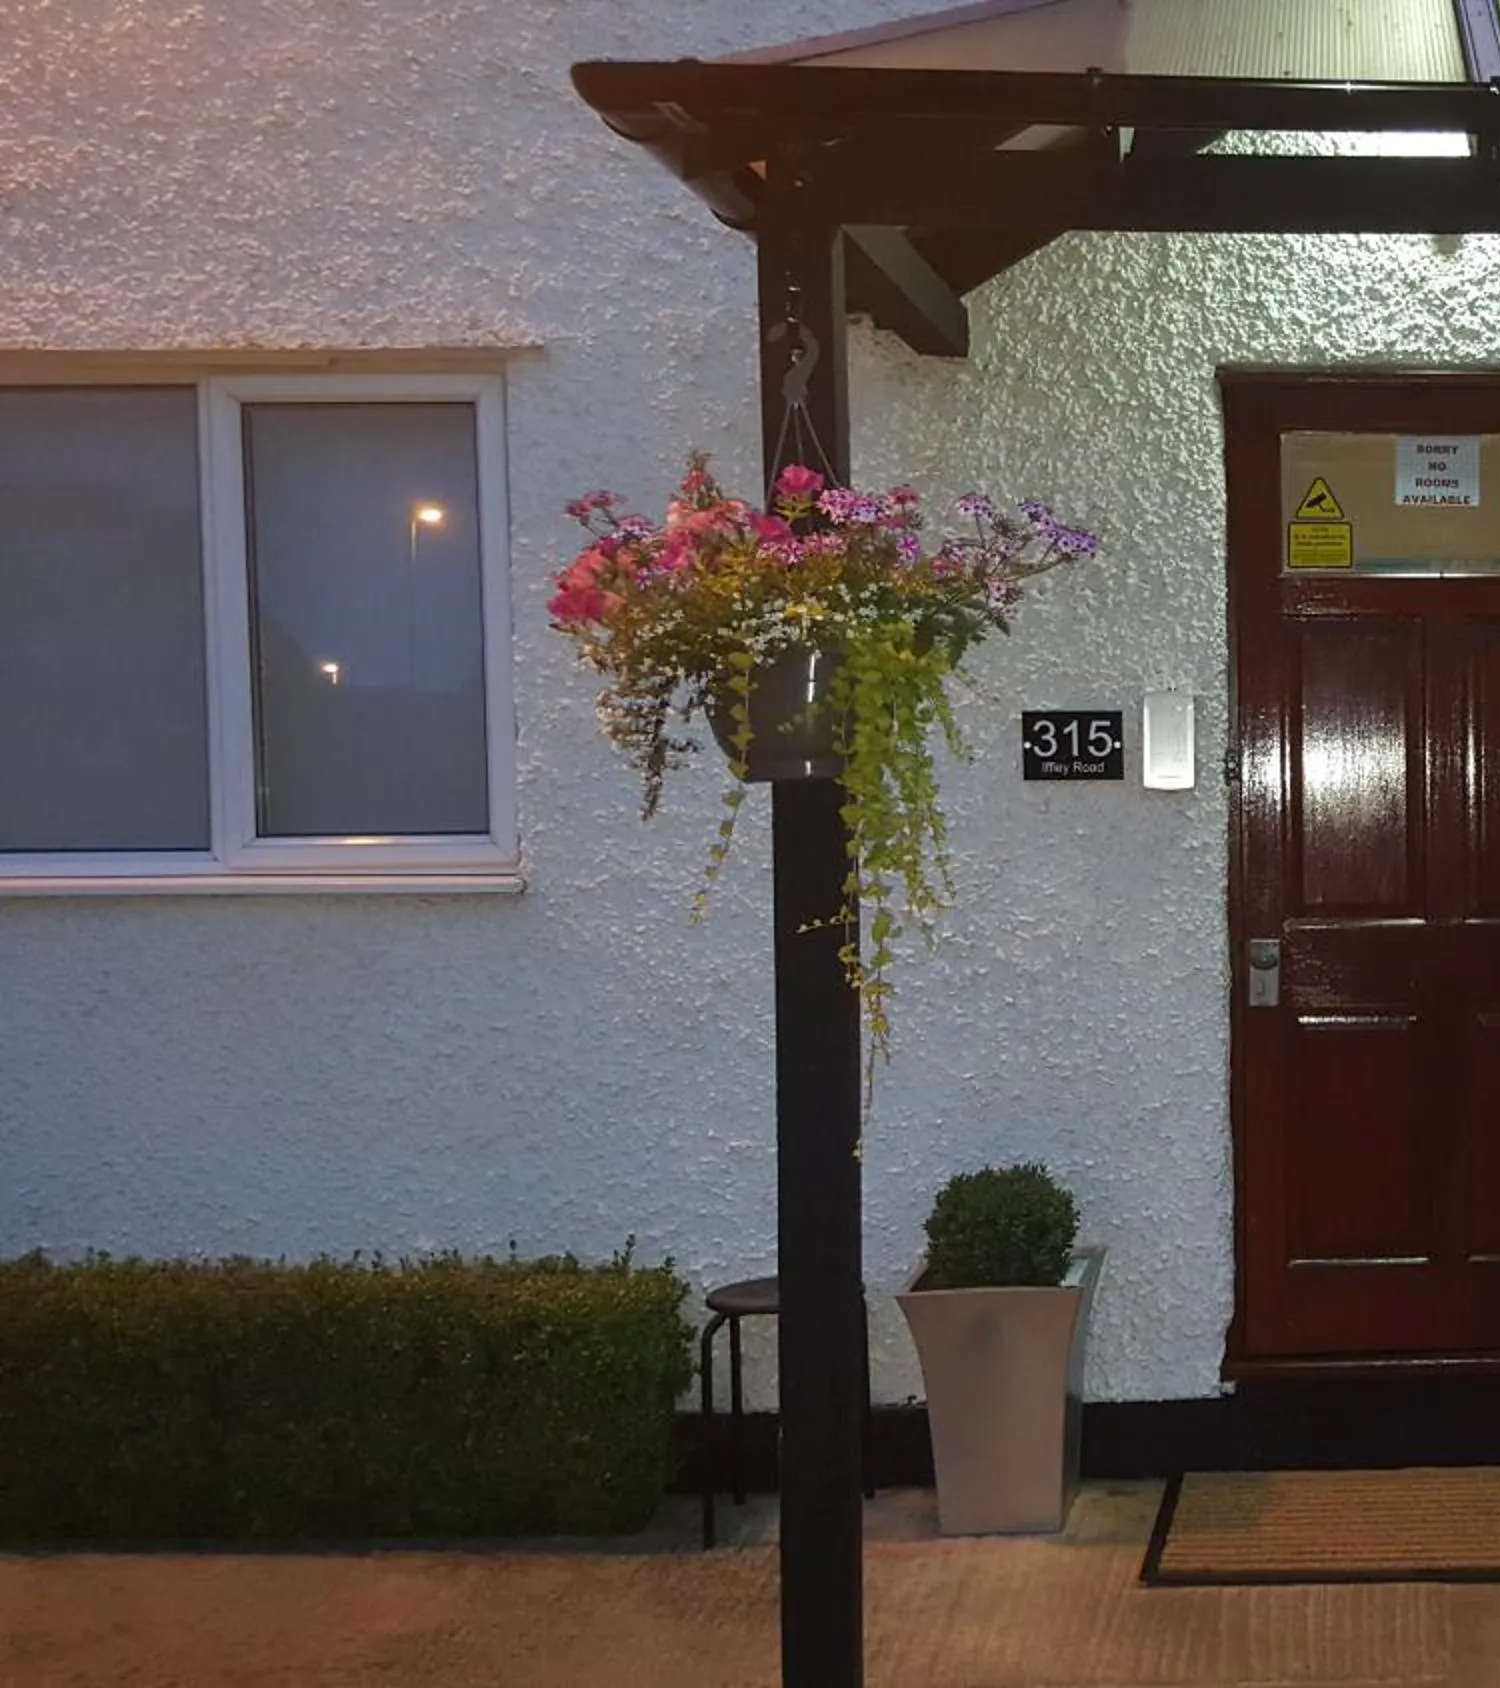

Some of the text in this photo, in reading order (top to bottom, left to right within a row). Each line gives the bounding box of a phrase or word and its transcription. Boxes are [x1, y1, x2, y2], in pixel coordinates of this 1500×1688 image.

[1416, 444, 1459, 455] SORRY
[1428, 461, 1447, 472] NO
[1415, 477, 1459, 488] ROOMS
[1403, 495, 1471, 505] AVAILABLE
[1032, 720, 1113, 757] 315
[1073, 761, 1105, 773] Road
